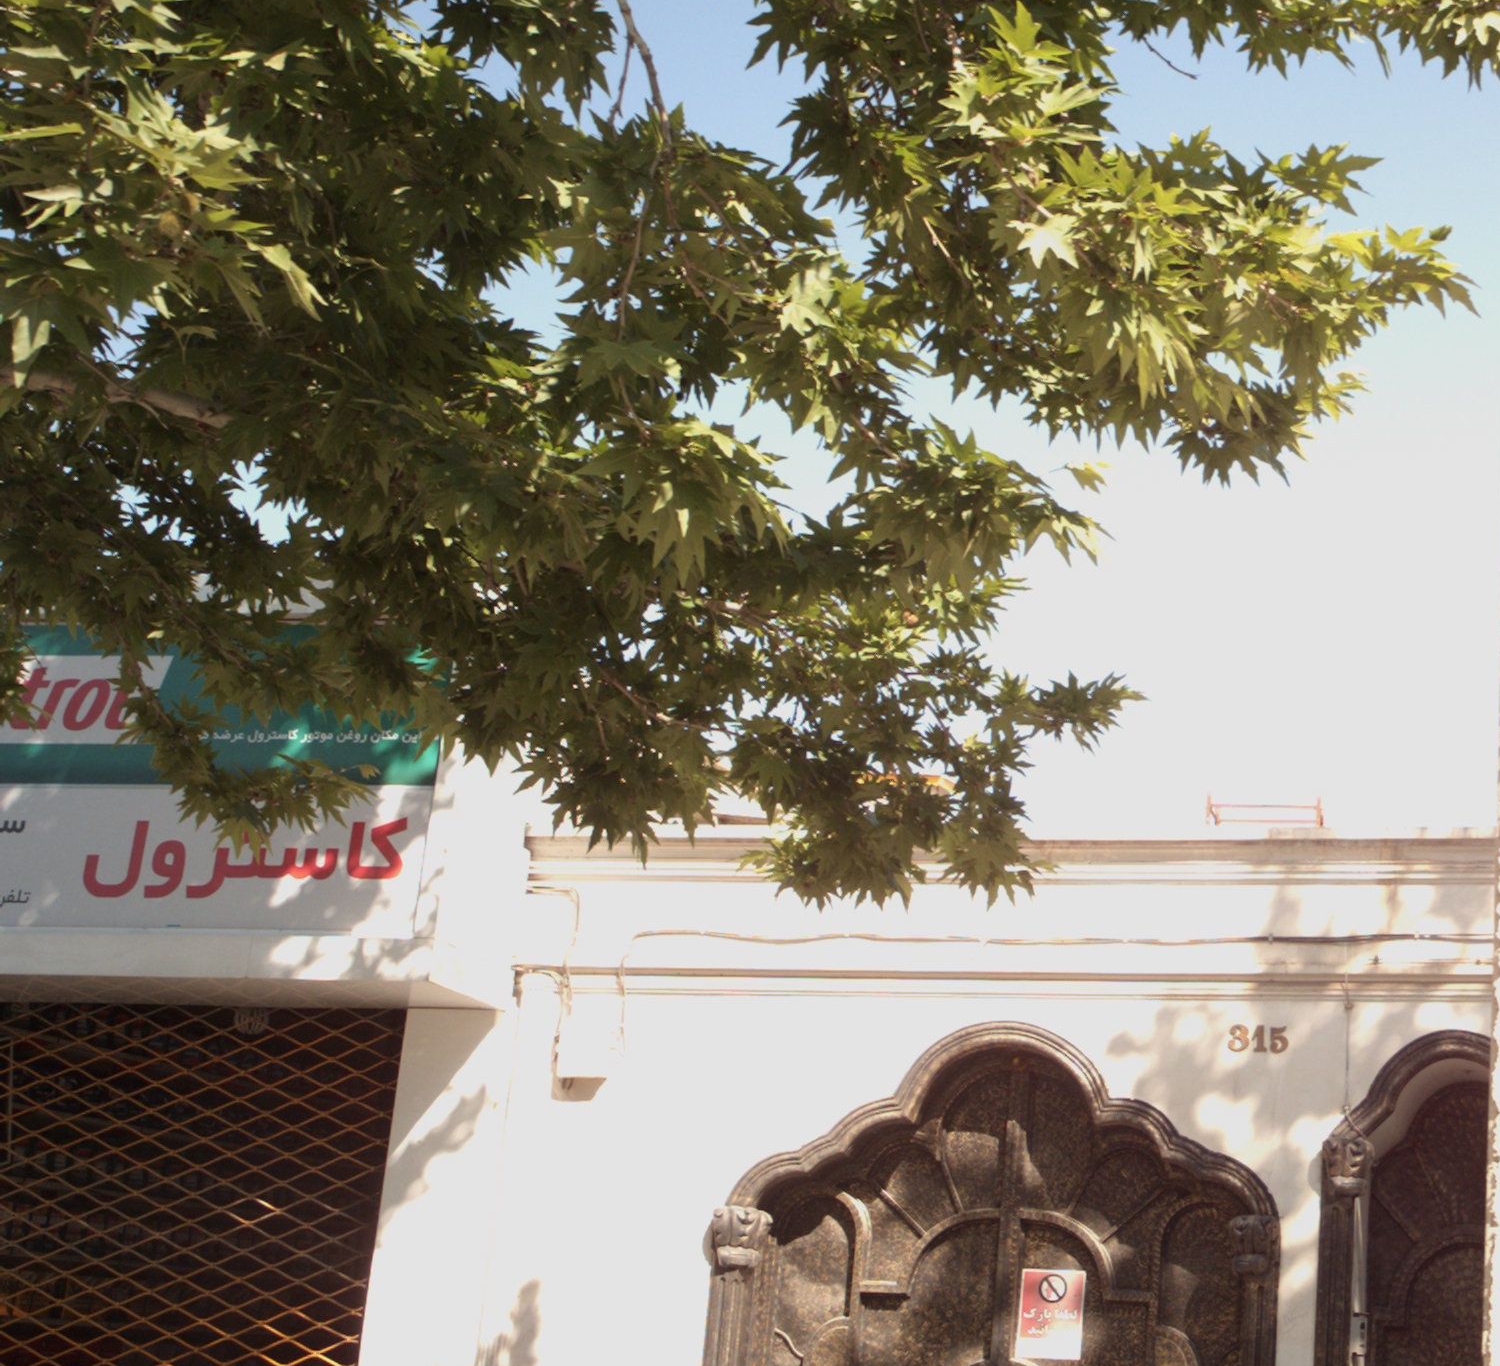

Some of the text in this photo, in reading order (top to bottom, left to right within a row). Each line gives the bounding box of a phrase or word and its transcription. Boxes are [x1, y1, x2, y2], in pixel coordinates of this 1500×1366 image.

[248, 729, 299, 744] کاسترول
[300, 731, 333, 744] موتور
[337, 730, 367, 743] روغن
[1227, 1024, 1289, 1054] 315
